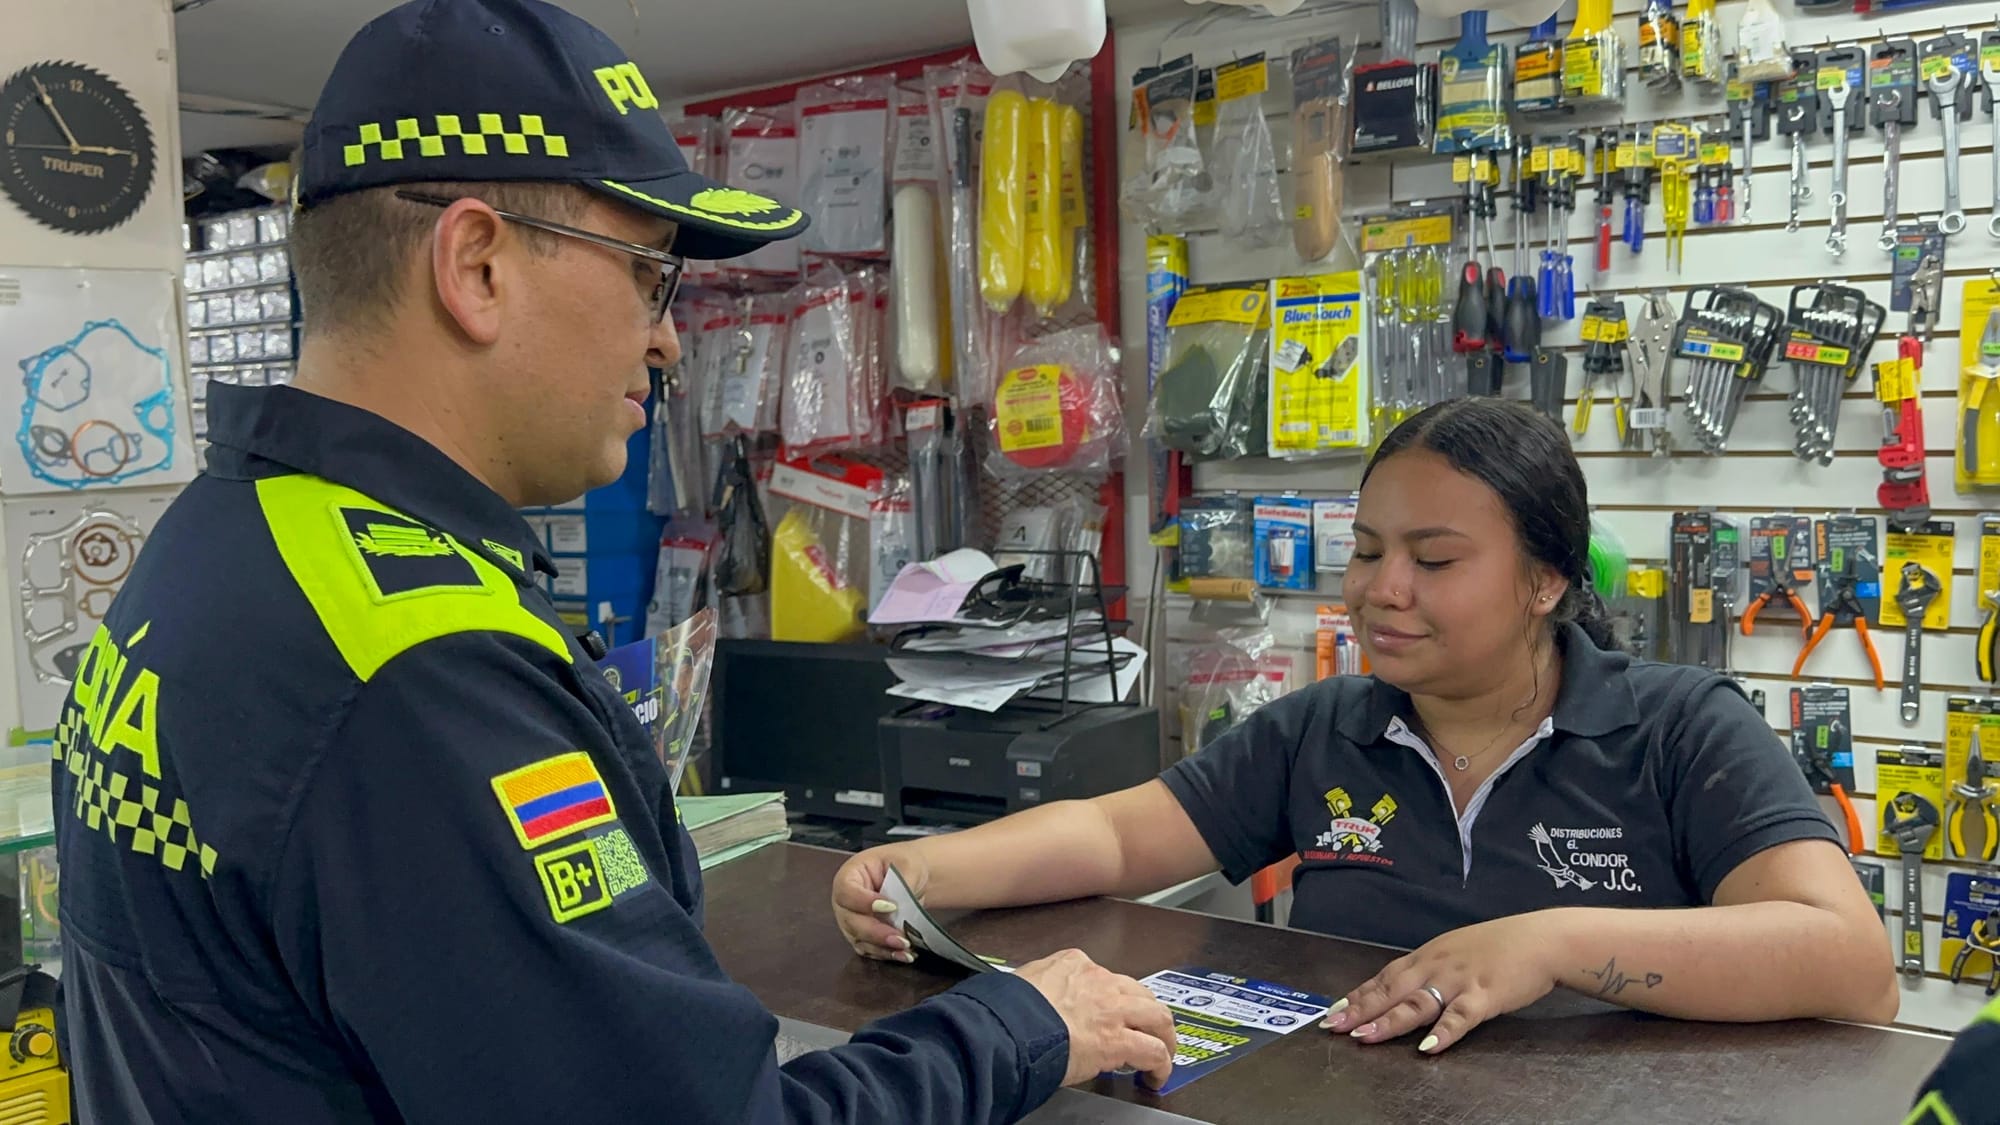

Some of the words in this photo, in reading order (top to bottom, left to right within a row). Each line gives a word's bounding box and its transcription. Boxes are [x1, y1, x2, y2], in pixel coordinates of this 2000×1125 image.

[69, 79, 84, 92] 12
[1376, 76, 1414, 91] BELLOTA
[41, 156, 105, 178] TRUPER
[1335, 820, 1378, 835] TRUK
[1550, 827, 1623, 839] DISTRIBUCIONES
[1570, 852, 1629, 868] CONDOR
[547, 861, 593, 909] B+
[1603, 868, 1642, 893] J.C.
